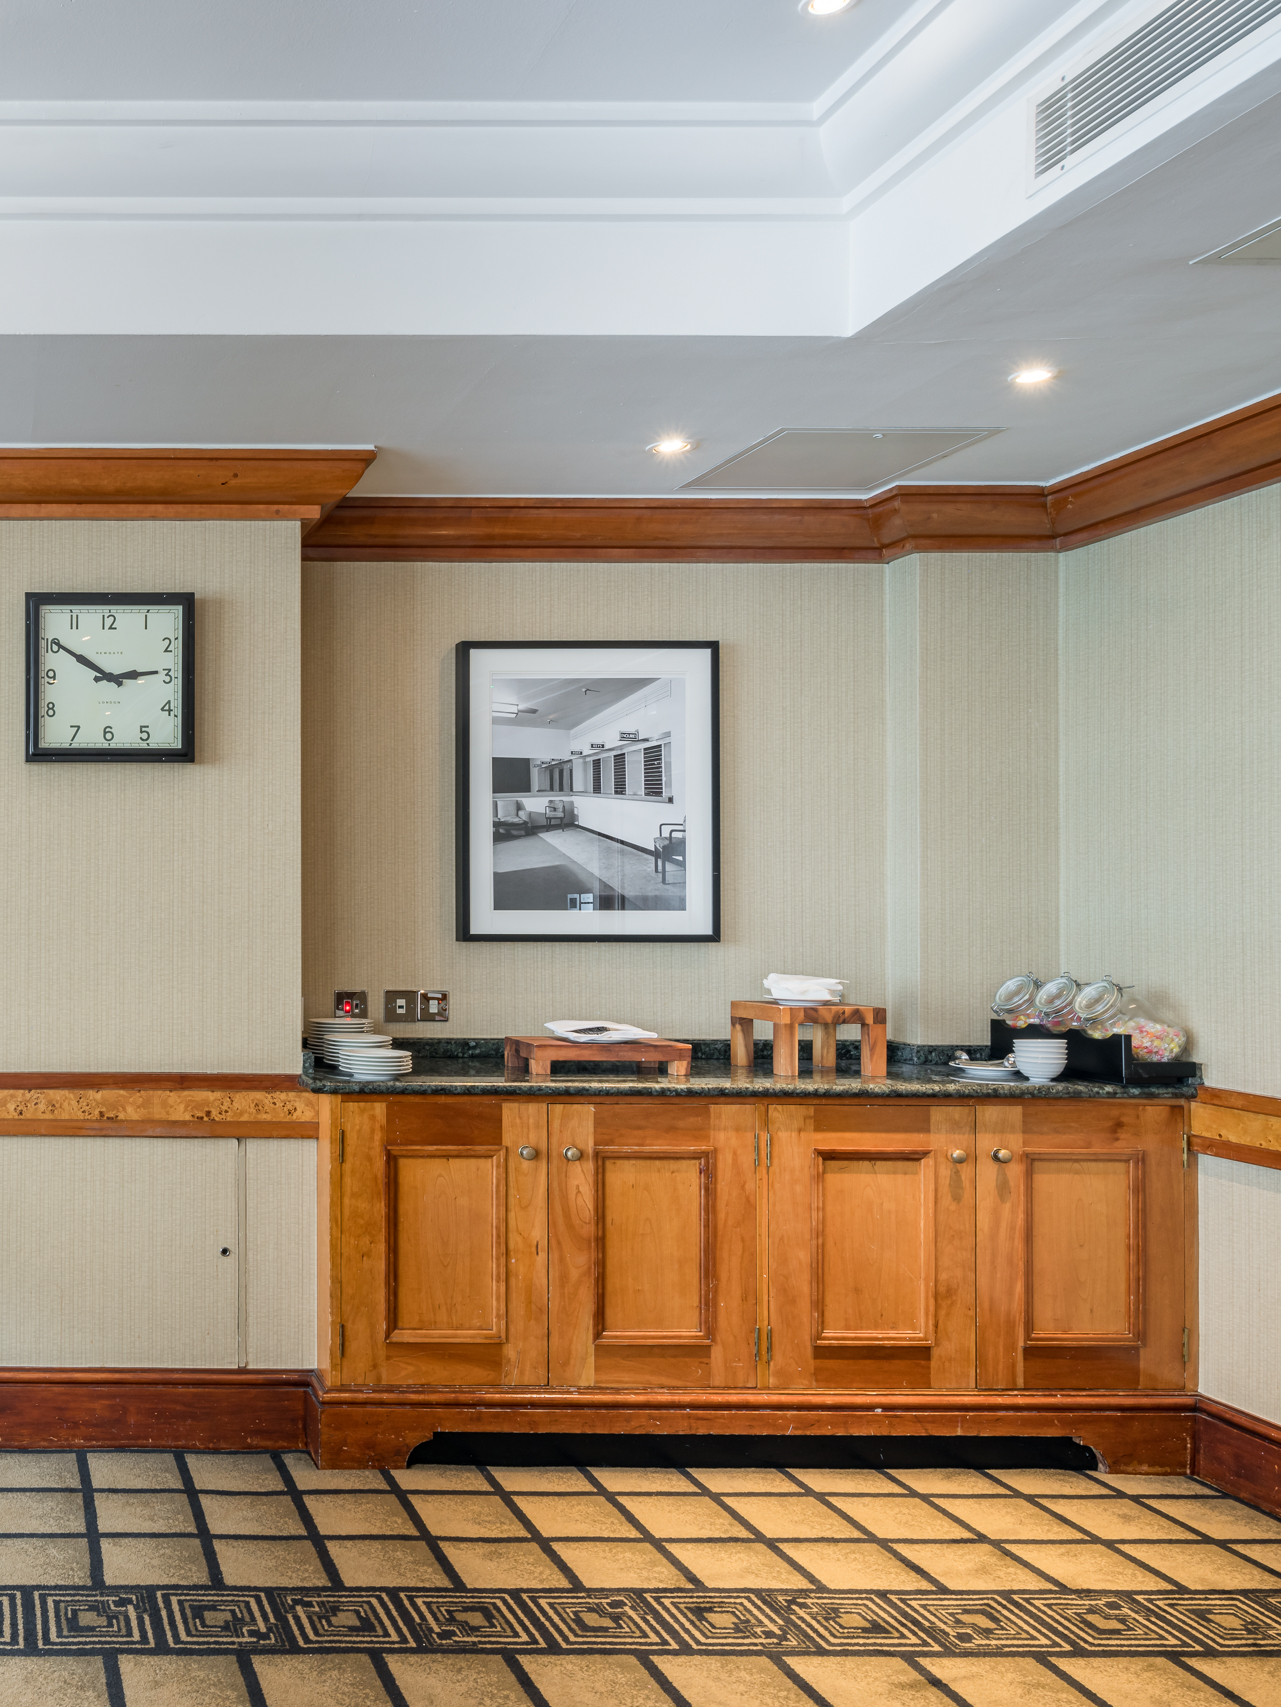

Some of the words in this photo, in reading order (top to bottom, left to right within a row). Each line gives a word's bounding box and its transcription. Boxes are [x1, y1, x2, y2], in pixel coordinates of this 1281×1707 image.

[70, 614, 79, 630] 11
[102, 614, 117, 630] 12
[46, 637, 61, 653] 10
[162, 637, 173, 653] 2
[46, 668, 57, 685] 9
[162, 668, 173, 684] 3
[46, 701, 56, 718] 8
[160, 700, 173, 716] 4
[70, 725, 81, 741] 7
[103, 725, 114, 742] 6
[139, 725, 150, 742] 5
